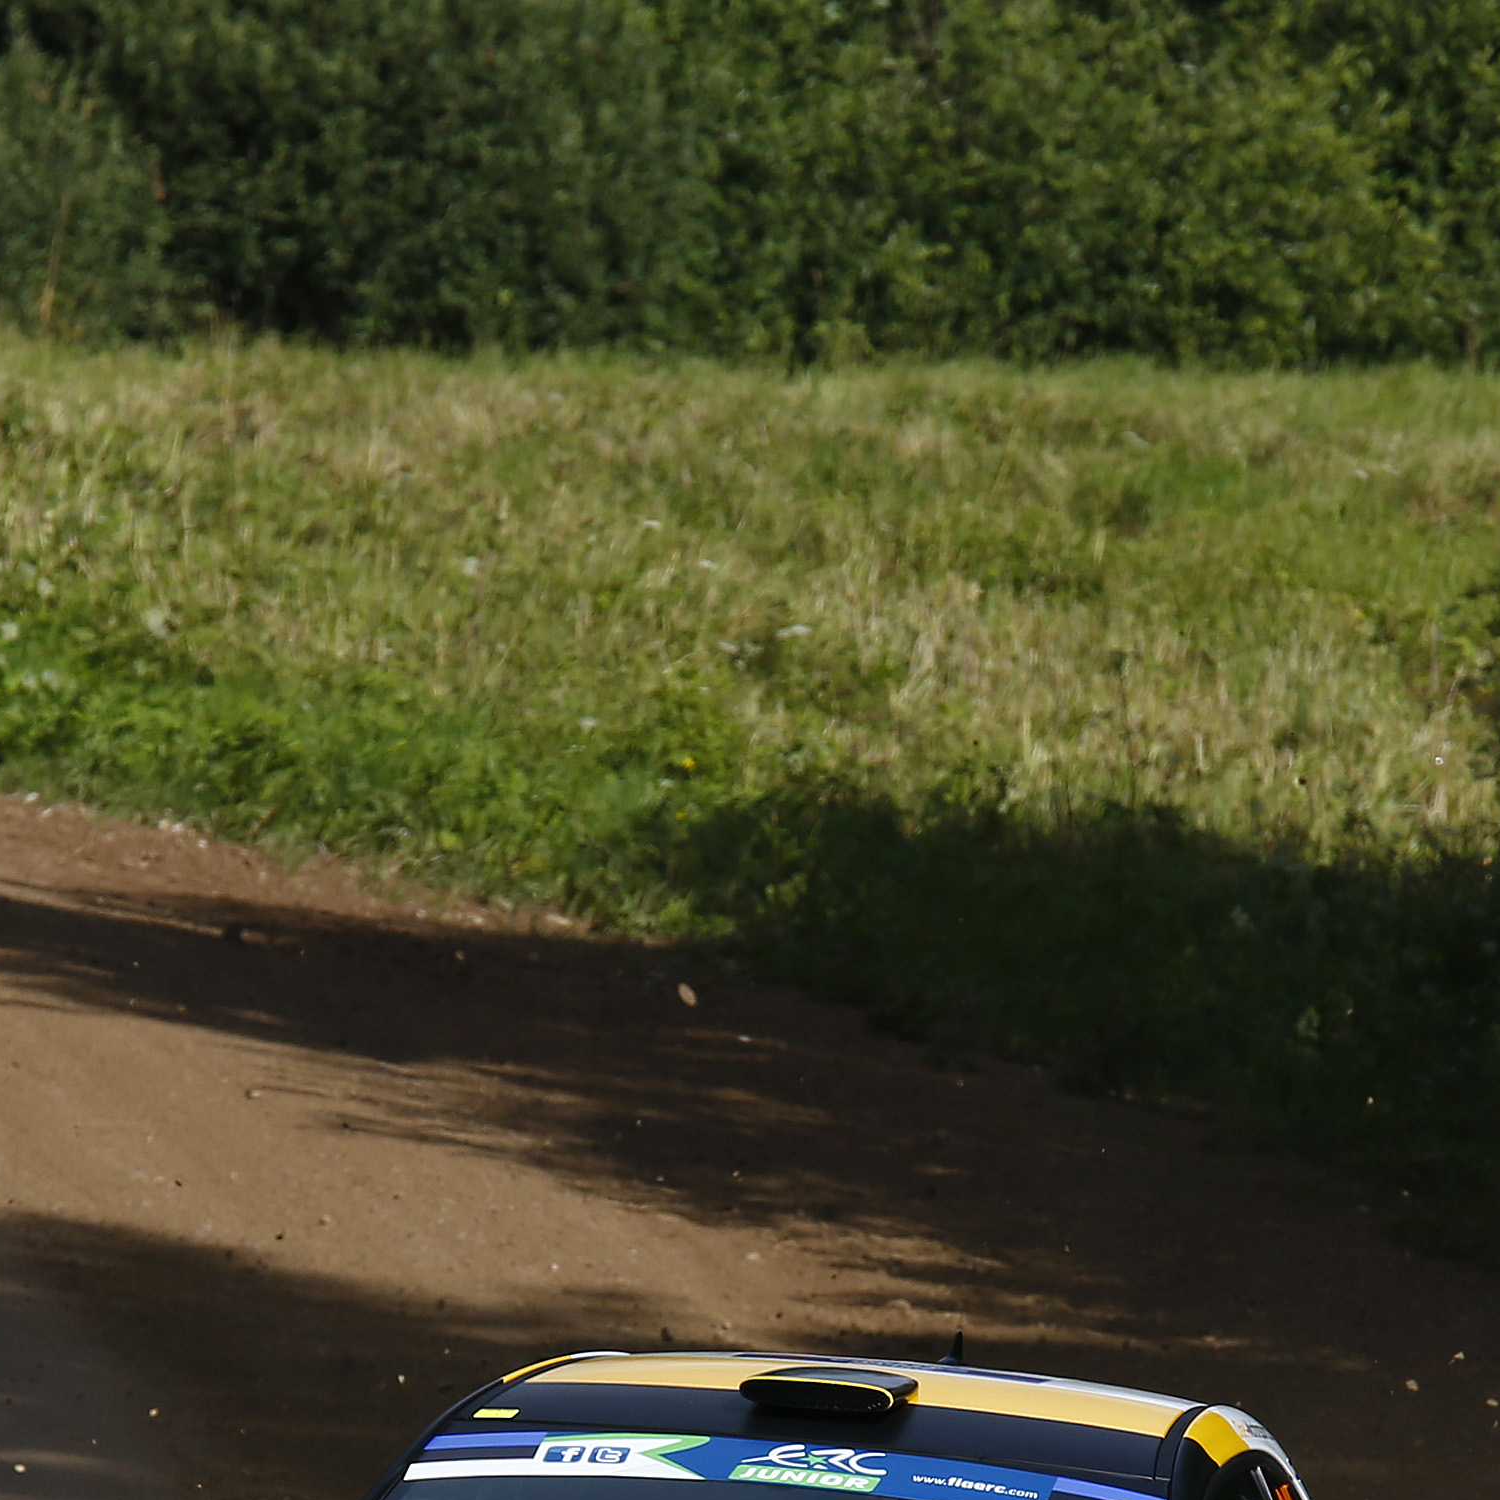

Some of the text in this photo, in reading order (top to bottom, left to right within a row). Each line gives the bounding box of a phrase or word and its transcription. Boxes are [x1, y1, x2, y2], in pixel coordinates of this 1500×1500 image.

[742, 1444, 887, 1475] ERC
[739, 1467, 870, 1490] JUNIOR
[912, 1474, 1039, 1500] www.fiaerc.com
